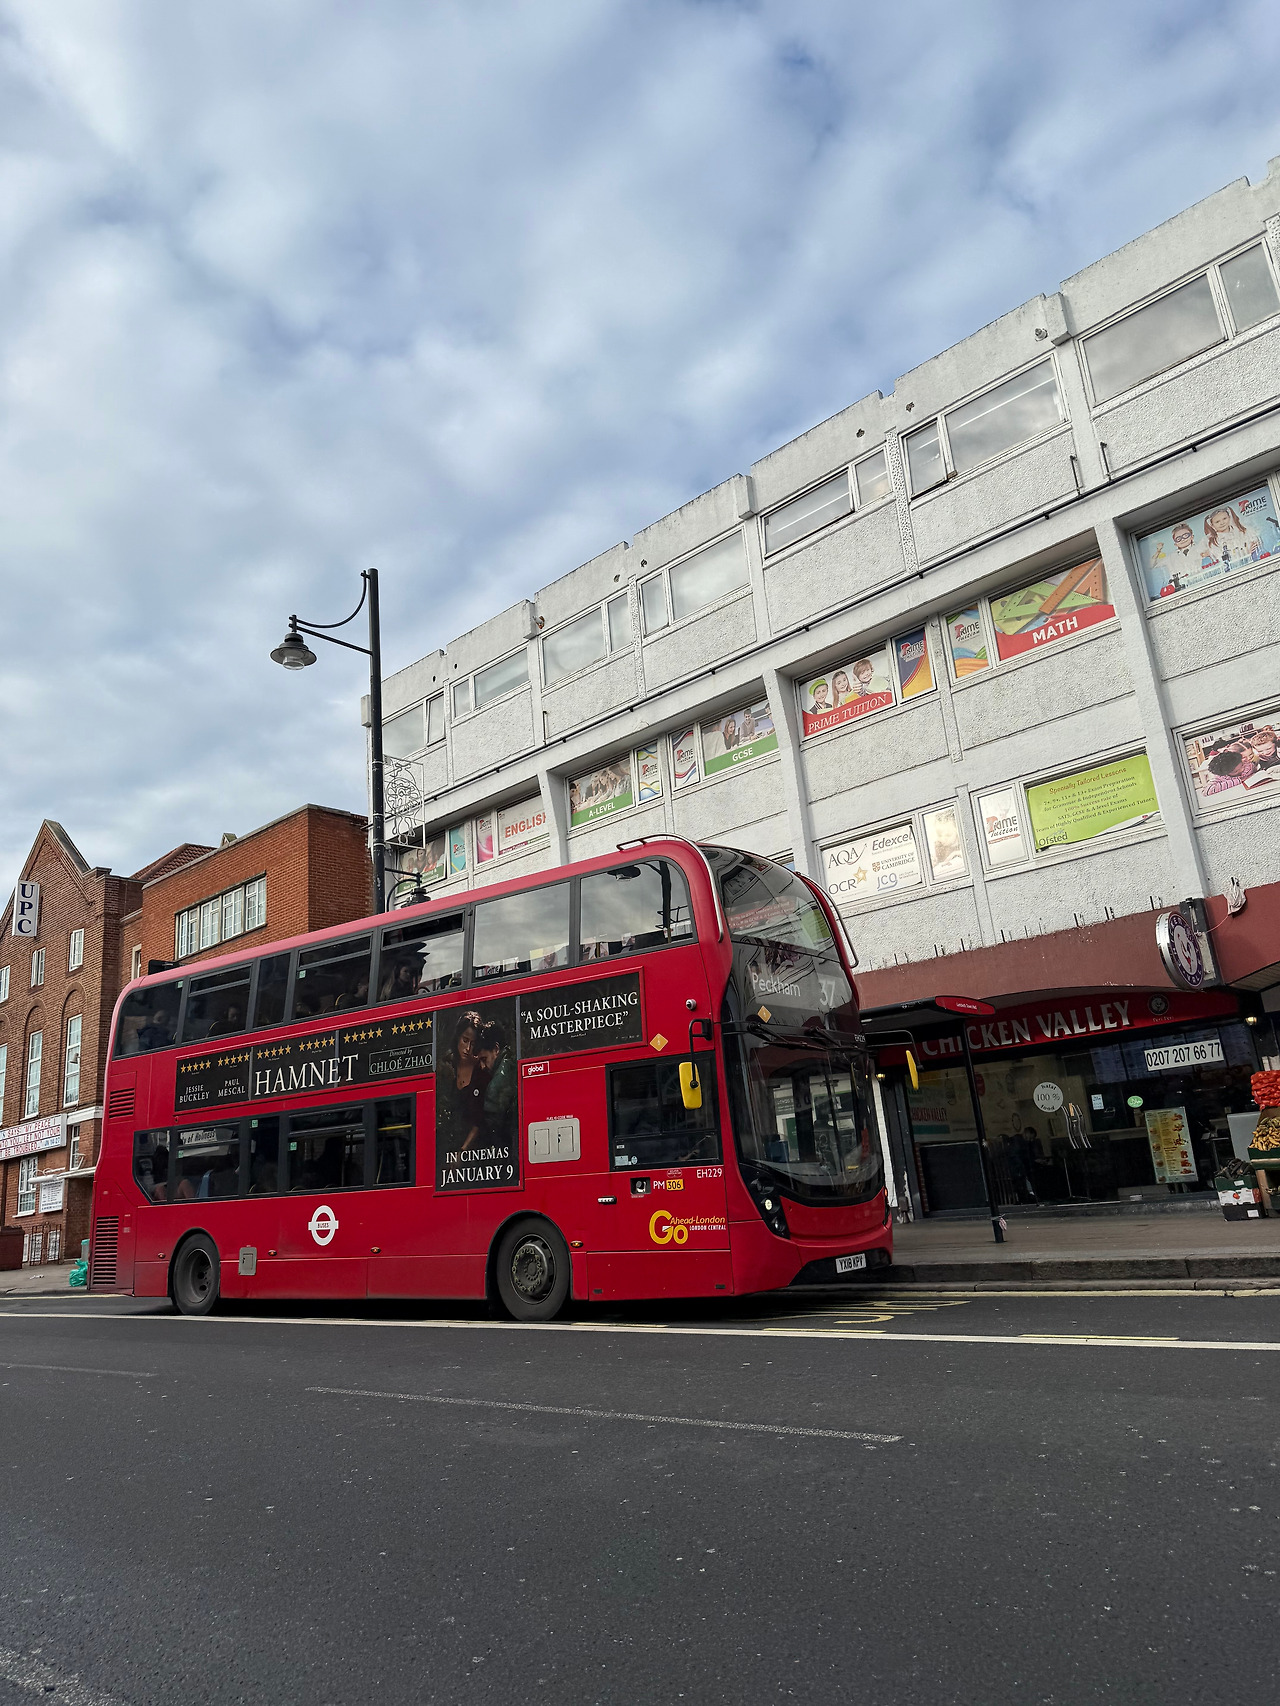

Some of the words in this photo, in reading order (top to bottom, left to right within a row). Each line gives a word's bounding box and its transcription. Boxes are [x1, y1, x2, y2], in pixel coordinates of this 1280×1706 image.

[1238, 496, 1267, 513] PRIME
[955, 621, 980, 639] PRIME
[1032, 616, 1079, 644] MATH
[808, 713, 840, 733] PRIME
[842, 694, 888, 719] TUITION
[732, 747, 754, 762] GCSE
[1050, 783, 1075, 794] Specially
[1077, 774, 1100, 786] Tailored
[1101, 768, 1127, 779] Lessons
[588, 802, 615, 818] A-LEVEL
[986, 815, 1018, 834] PRIME
[872, 830, 912, 851] Edexcel
[1039, 832, 1068, 847] Ofsted
[828, 848, 858, 869] AQA
[881, 854, 907, 864] UNIVERSITY
[882, 857, 915, 870] CAMBRIDGE
[828, 878, 857, 894] OCR
[752, 972, 801, 996] Peckham
[819, 980, 836, 1007] 37
[536, 991, 638, 1022] SOUL-SHAKING
[530, 1010, 629, 1039] MASTERPIECE”
[922, 1018, 1032, 1056] CHICKEN
[1036, 1000, 1133, 1038] VALLEY
[370, 1057, 403, 1074] CHLOÉ
[405, 1053, 432, 1068] ZHAO
[1146, 1050, 1170, 1067] 0207
[1172, 1047, 1191, 1063] 207
[1193, 1044, 1207, 1060] 66
[1208, 1042, 1222, 1058] 77
[254, 1054, 359, 1096] HAMNET
[527, 1064, 544, 1075] global
[186, 1084, 204, 1095] JESSIE
[218, 1085, 246, 1098] MESCAL
[224, 1078, 240, 1087] PAUL
[179, 1092, 210, 1104] BUCKLEY
[1037, 1094, 1050, 1102] 100
[446, 1152, 458, 1164] IN
[461, 1146, 509, 1162] CINEMAS
[441, 1166, 503, 1187] JANUARY
[506, 1165, 514, 1180] 9
[696, 1168, 722, 1179] EH229
[653, 1180, 665, 1189] PM
[667, 1181, 682, 1190] 306
[649, 1210, 688, 1244] Go
[670, 1215, 725, 1225] Ahead-London
